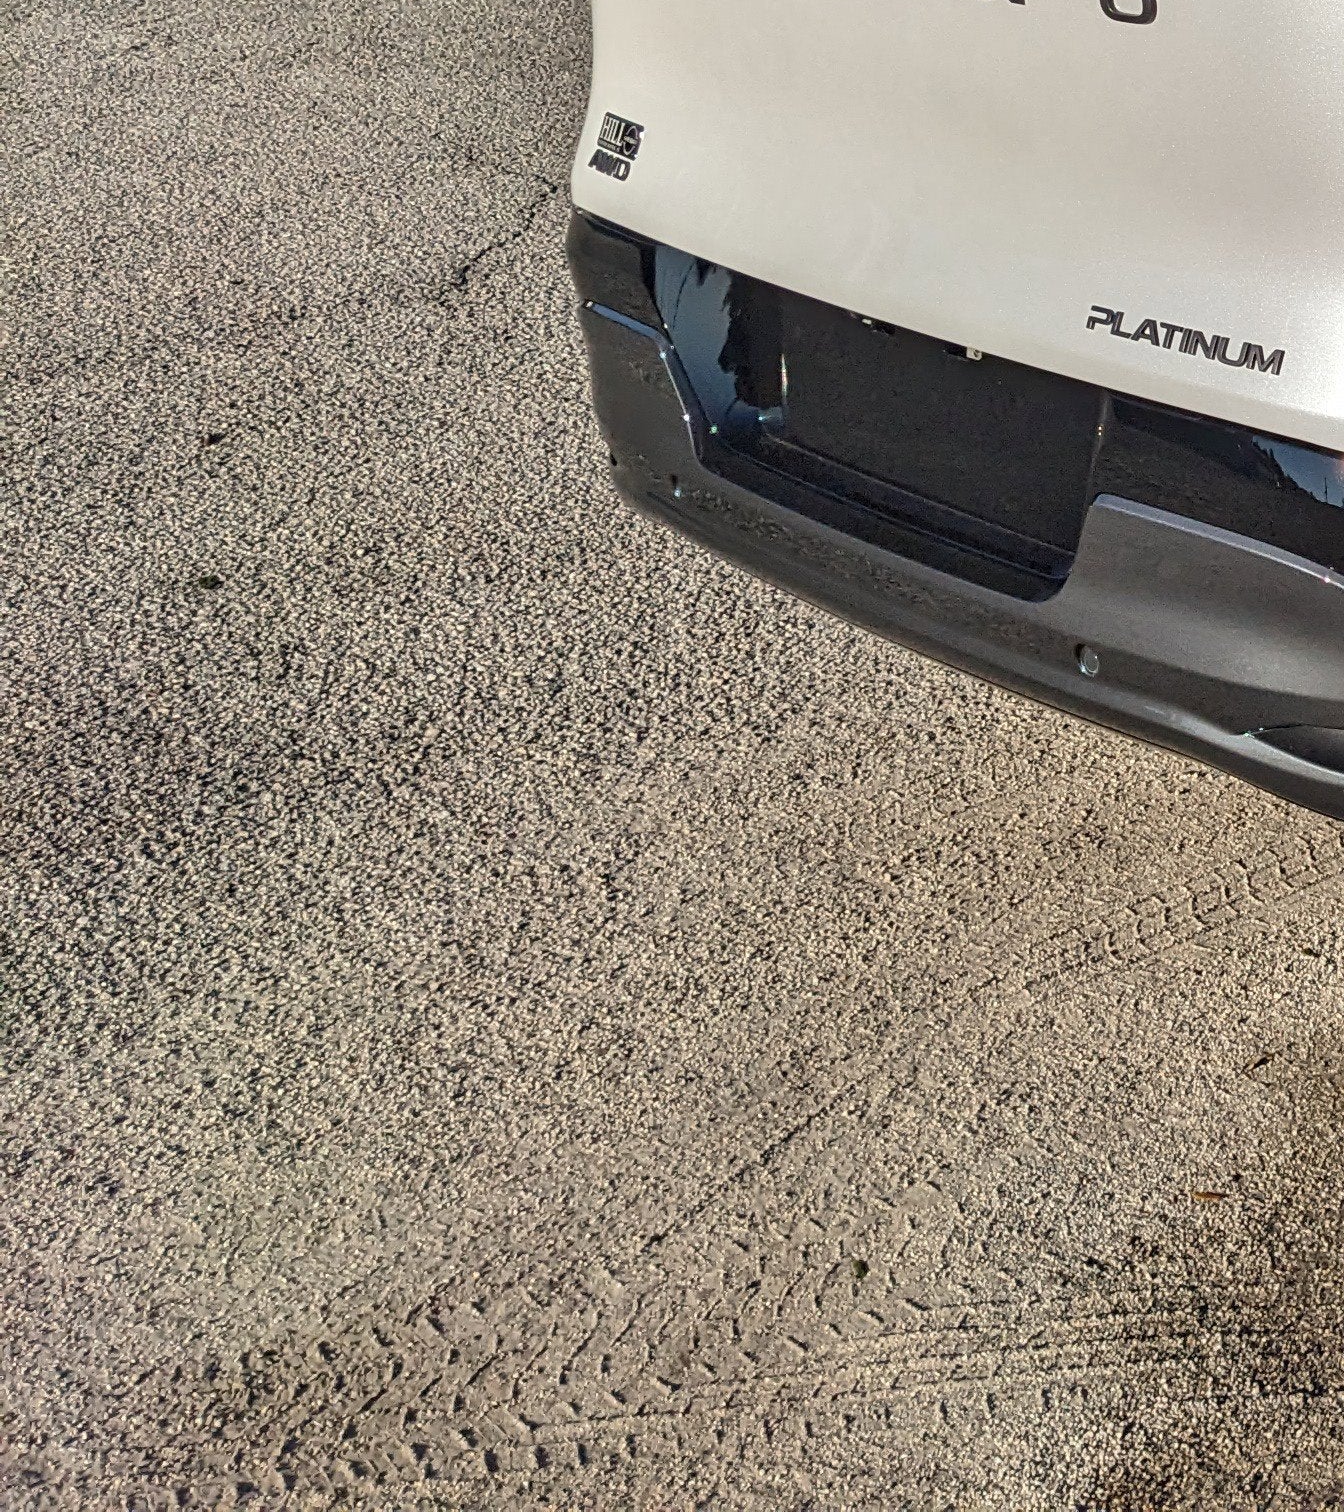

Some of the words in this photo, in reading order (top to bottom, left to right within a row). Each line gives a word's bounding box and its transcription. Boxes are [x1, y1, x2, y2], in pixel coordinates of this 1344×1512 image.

[600, 115, 626, 147] HILL
[588, 148, 631, 182] AWD
[1086, 304, 1286, 376] PLATINUM
